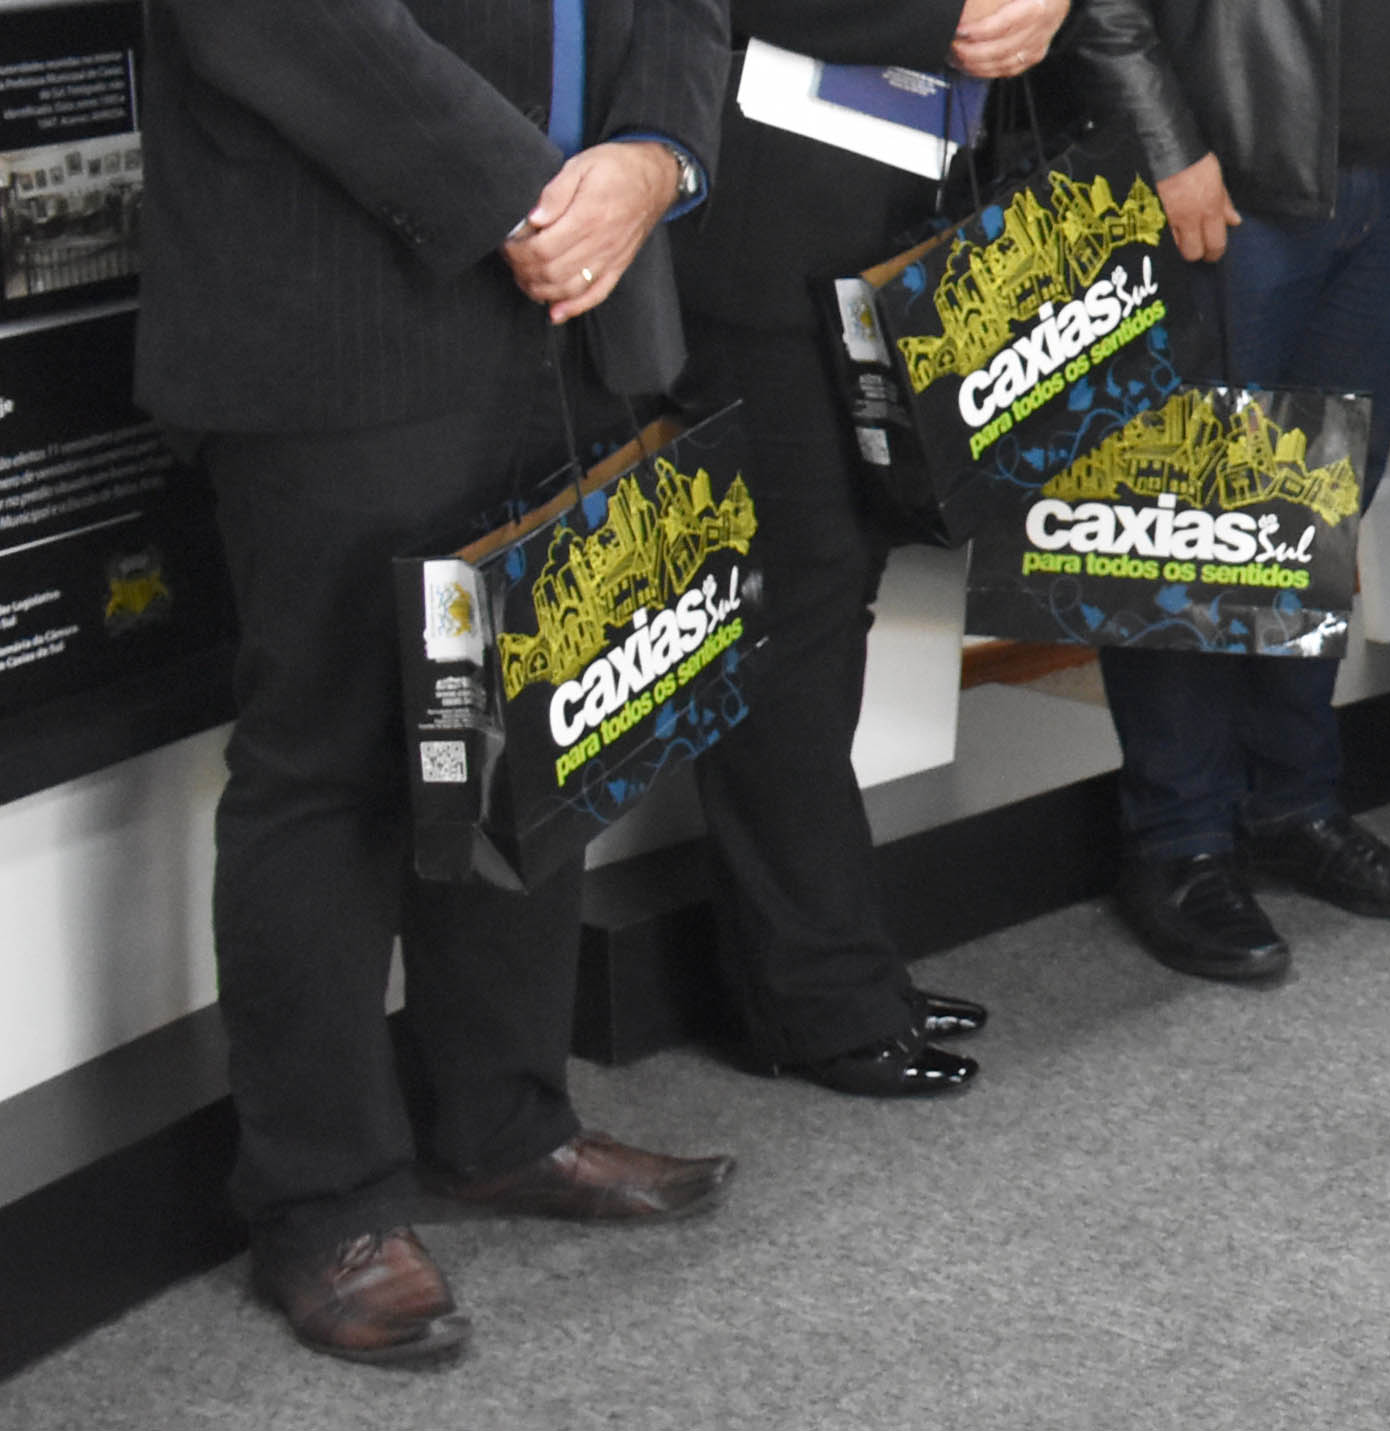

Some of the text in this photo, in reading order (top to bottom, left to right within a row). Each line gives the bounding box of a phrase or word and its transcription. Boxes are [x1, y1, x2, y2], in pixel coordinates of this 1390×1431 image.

[957, 279, 1121, 427] caxias
[1116, 255, 1159, 318] Sul
[969, 299, 1166, 460] para todos os sentidos
[1022, 549, 1310, 590] para todos os sentidos
[1025, 493, 1260, 565] caxias
[1257, 525, 1314, 564] Sul
[549, 587, 708, 748] caxias
[707, 565, 741, 634] Sul
[554, 616, 744, 787] para todos os sentidos
